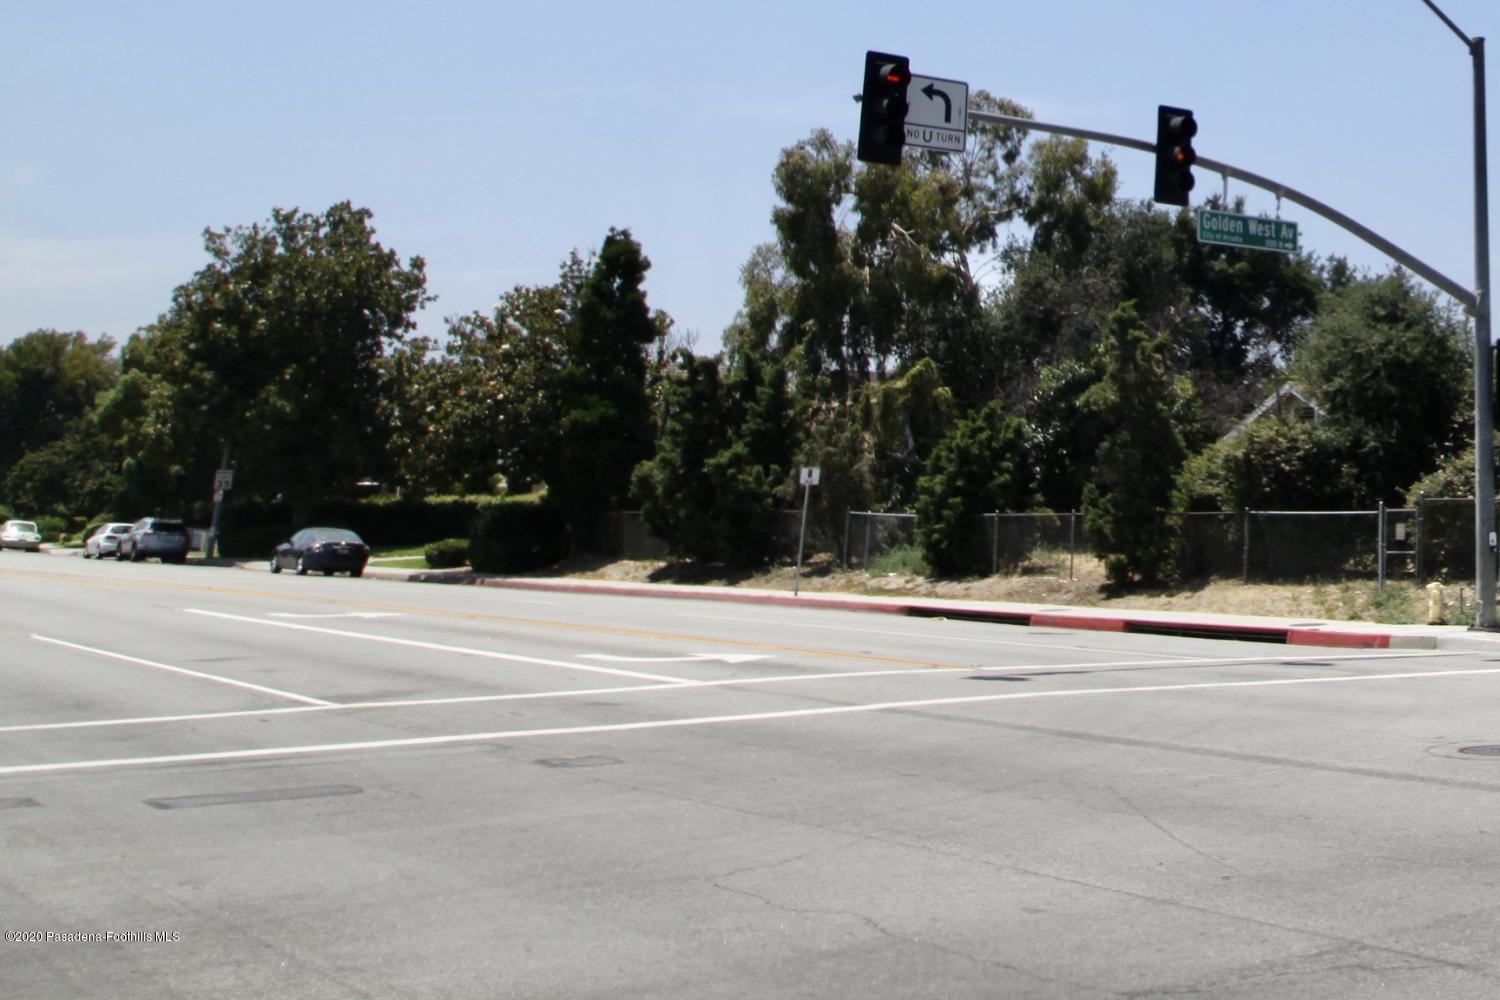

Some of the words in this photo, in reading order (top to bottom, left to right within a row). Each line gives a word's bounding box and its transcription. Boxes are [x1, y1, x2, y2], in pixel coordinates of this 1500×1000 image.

[906, 128, 920, 139] NO
[923, 130, 933, 143] U
[936, 132, 961, 144] TURN
[1203, 213, 1244, 234] Golden
[1248, 219, 1276, 238] West
[1281, 223, 1295, 240] Av
